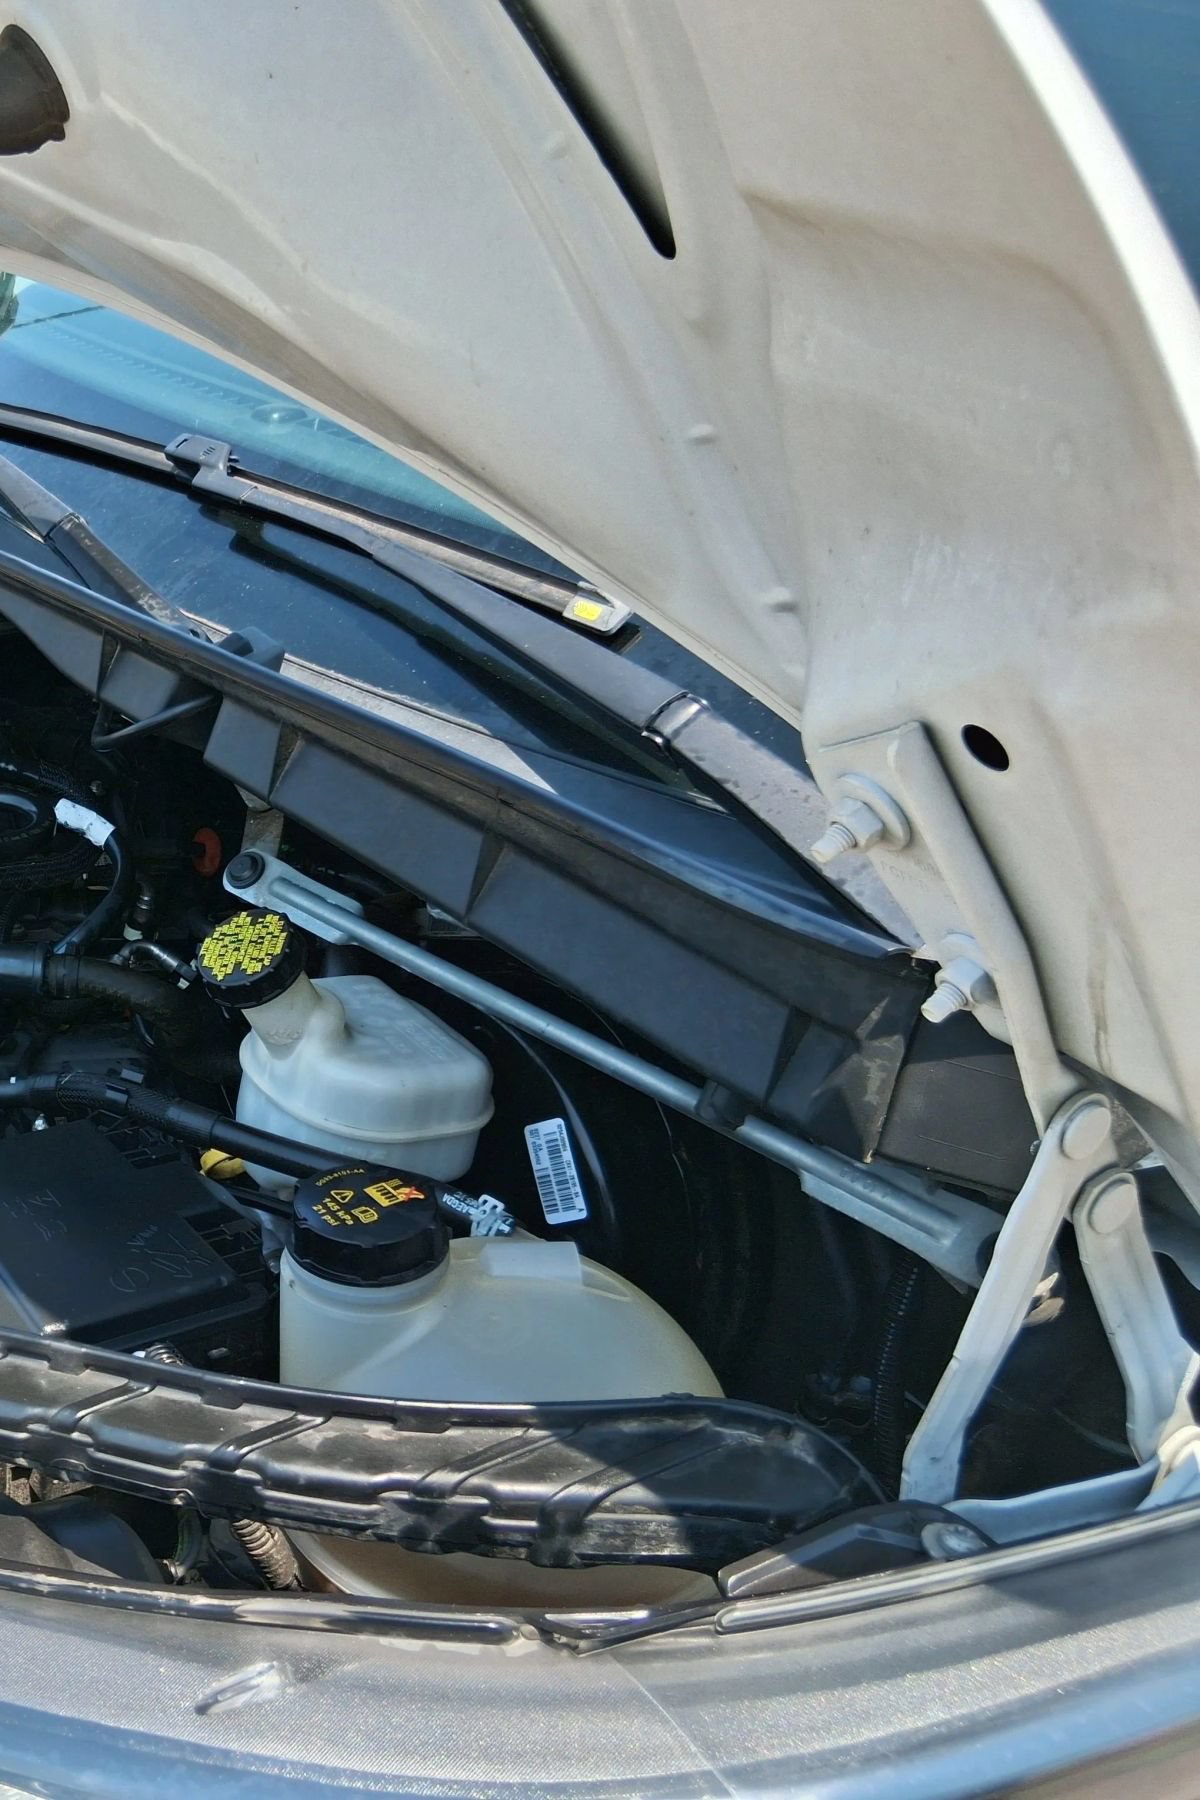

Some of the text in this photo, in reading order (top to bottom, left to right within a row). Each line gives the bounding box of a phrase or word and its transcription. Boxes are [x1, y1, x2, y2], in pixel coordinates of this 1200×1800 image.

[312, 1204, 341, 1226] 21 psi
[322, 1198, 355, 1226] 145 kPa
